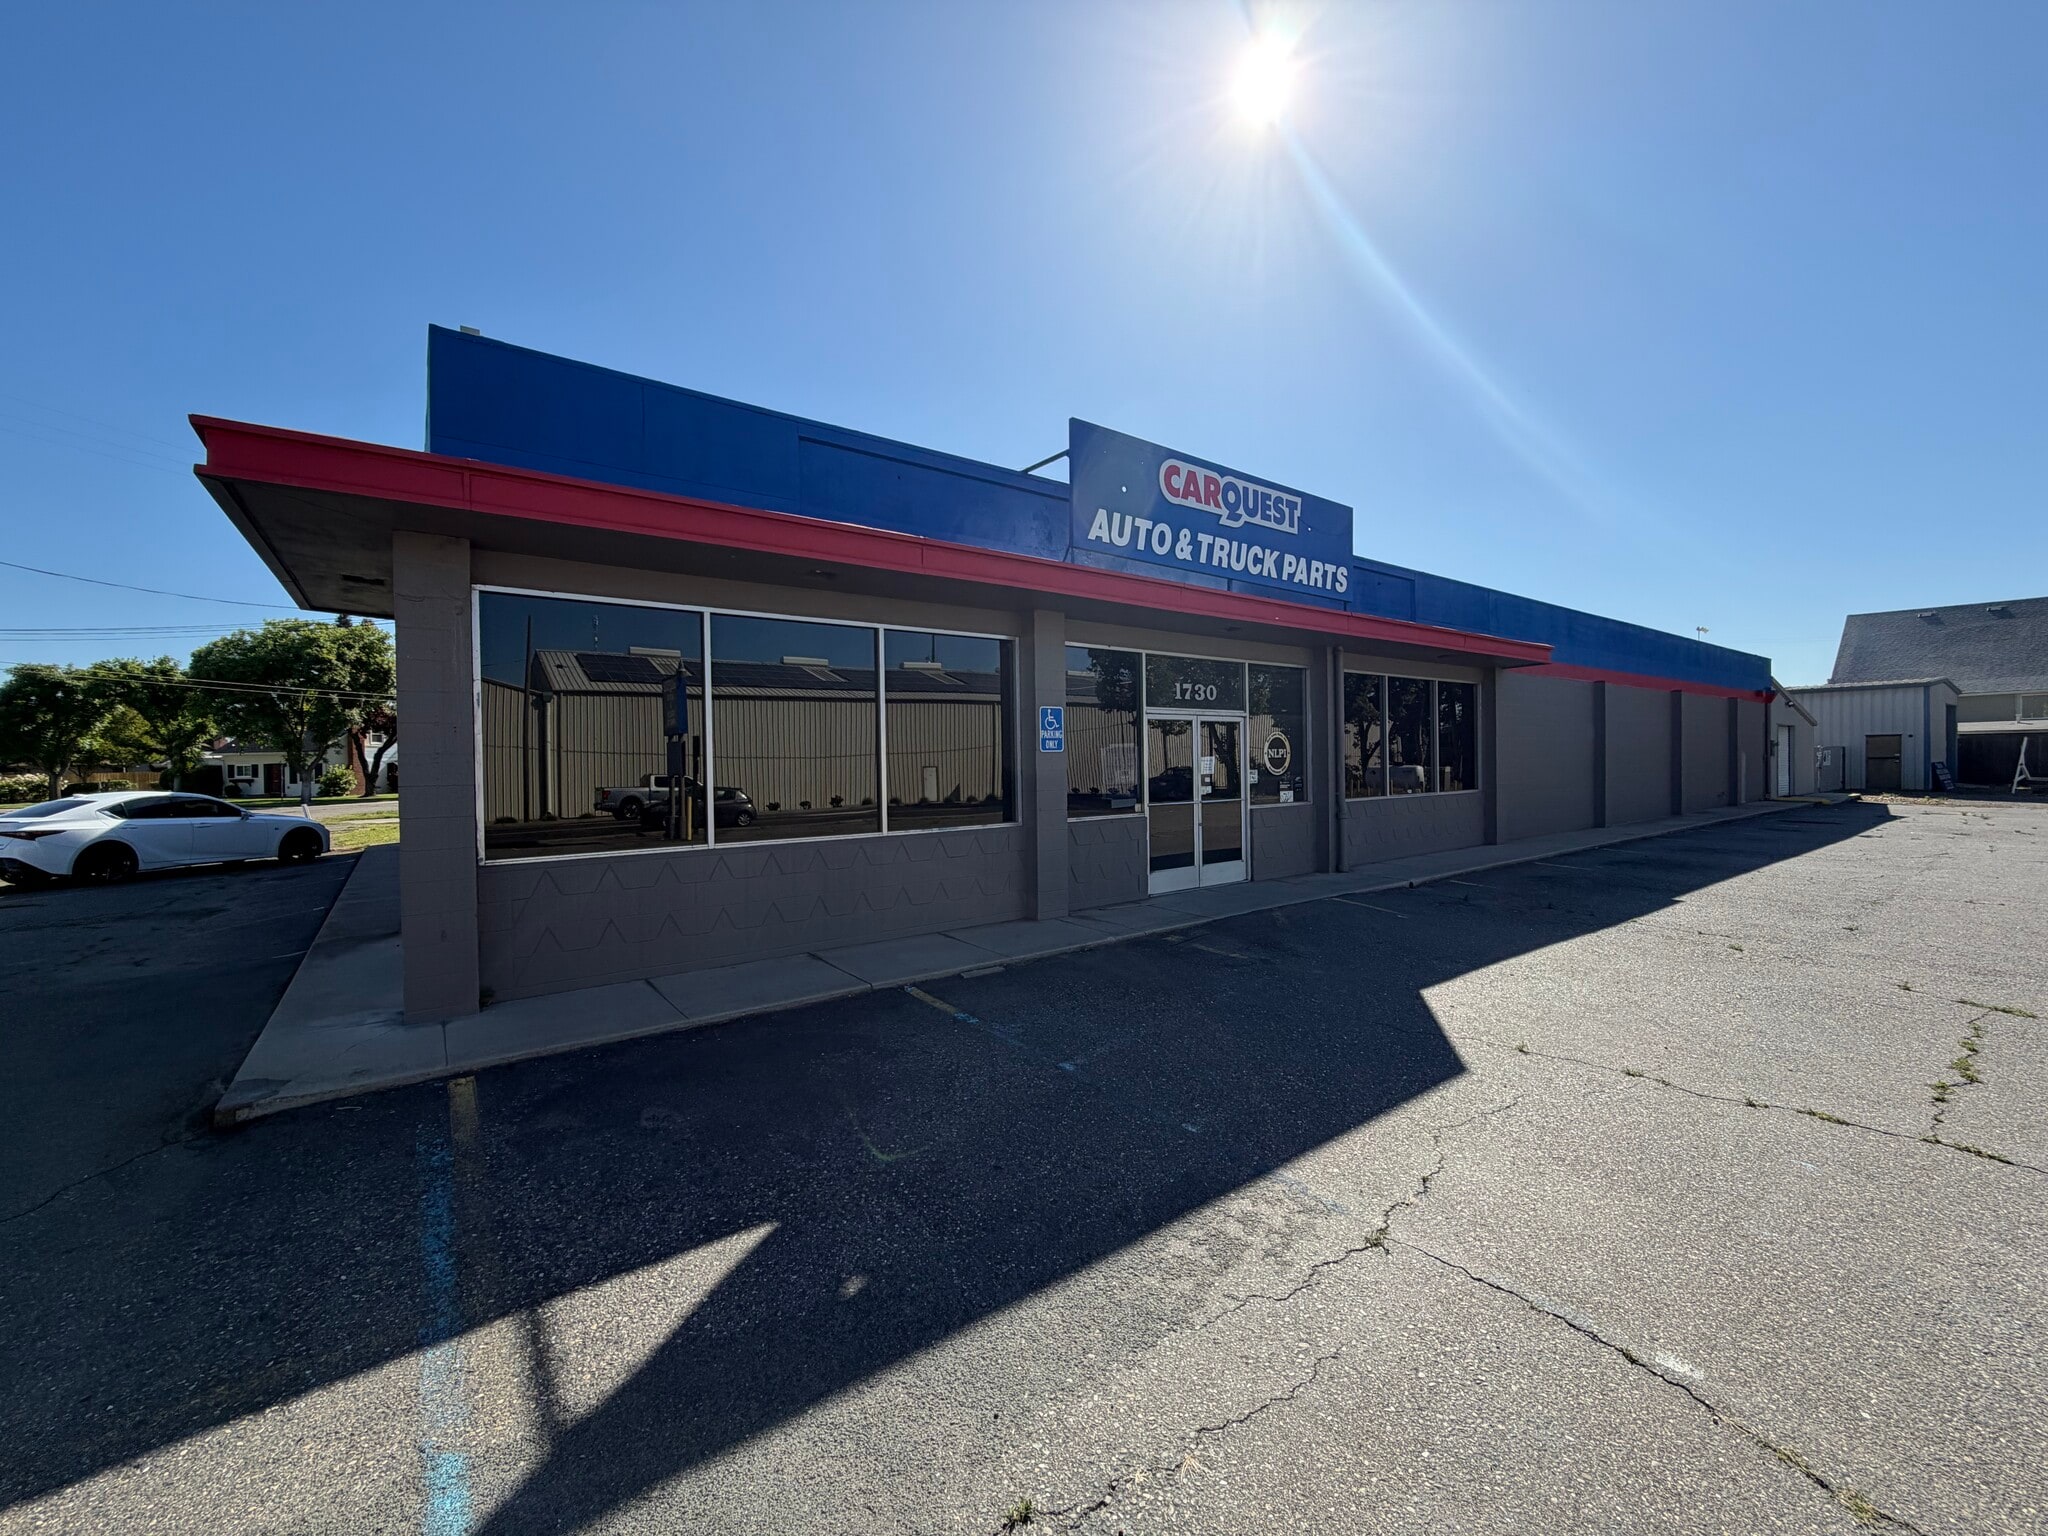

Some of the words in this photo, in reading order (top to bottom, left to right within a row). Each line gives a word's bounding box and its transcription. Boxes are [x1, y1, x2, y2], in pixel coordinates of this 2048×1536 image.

[1162, 463, 1300, 530] CARQUEST
[1087, 508, 1172, 556] AUTO
[1174, 528, 1193, 561] &
[1197, 532, 1280, 579] TRUCK
[1282, 553, 1349, 593] PARTS
[1174, 682, 1217, 701] 1730
[1041, 730, 1063, 739] PARKING
[1046, 740, 1059, 749] ONLY
